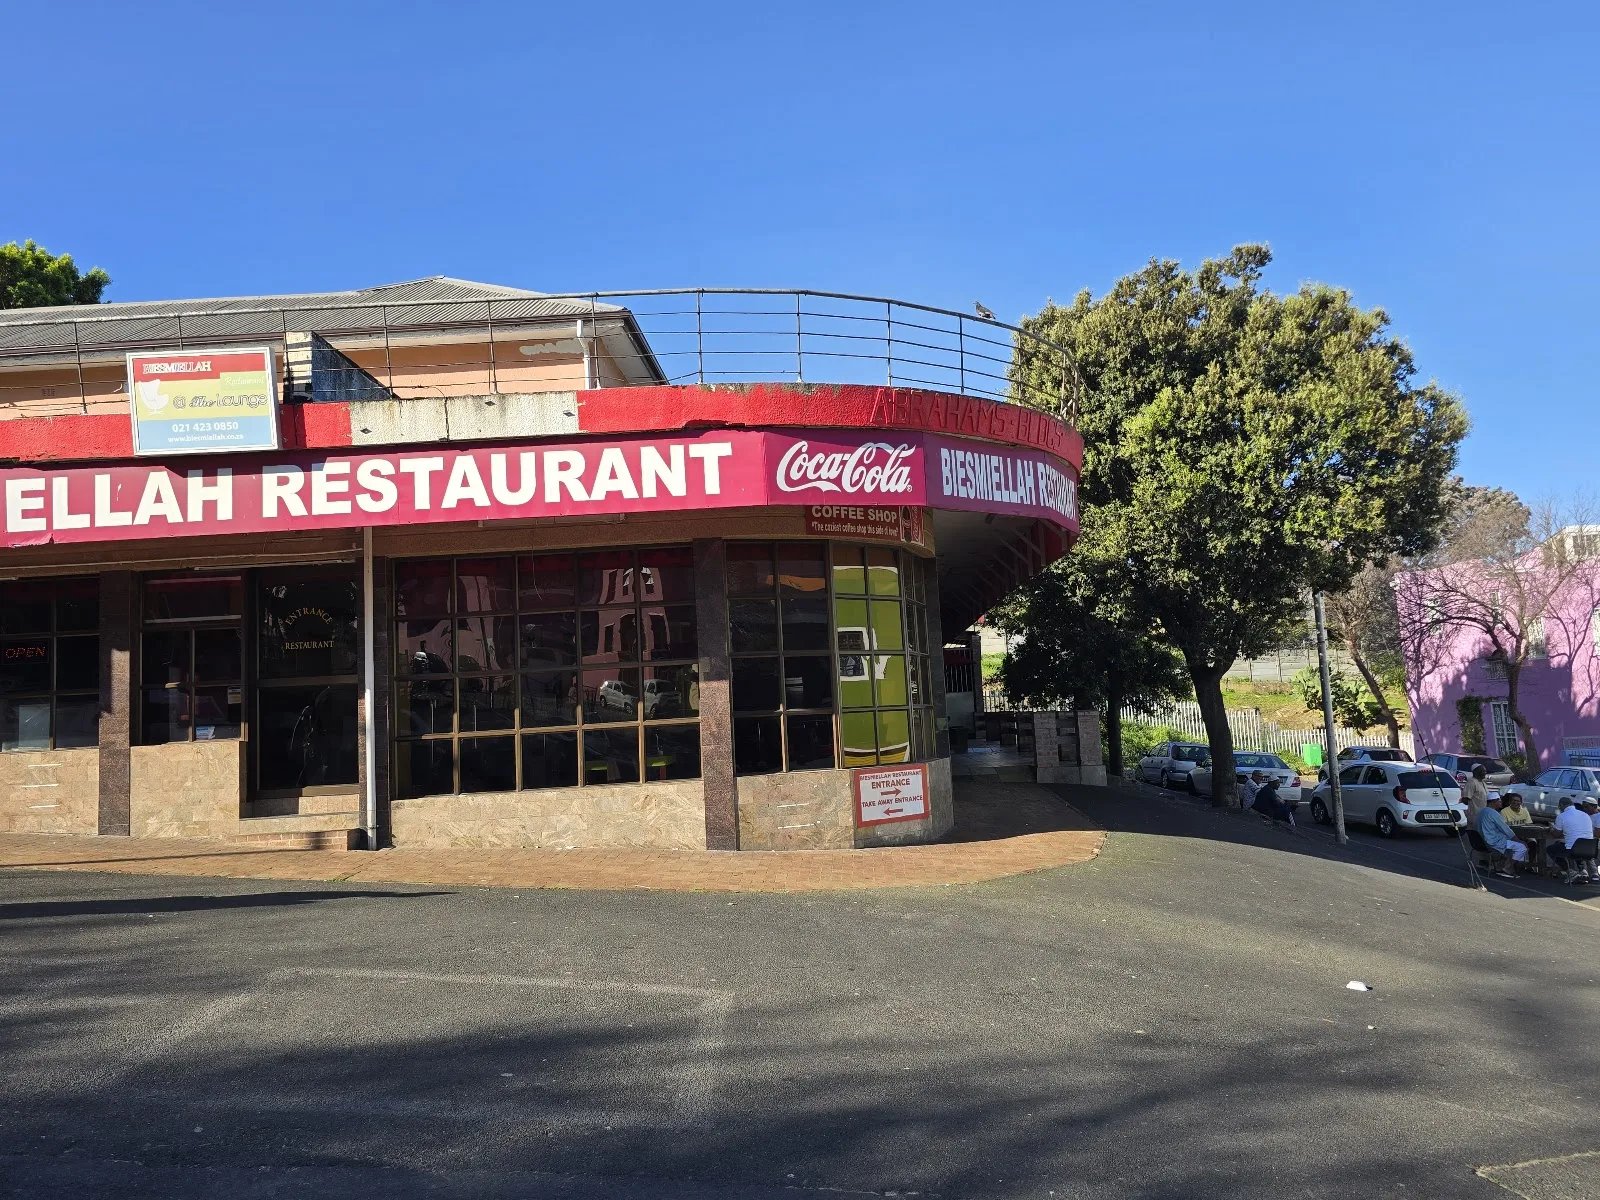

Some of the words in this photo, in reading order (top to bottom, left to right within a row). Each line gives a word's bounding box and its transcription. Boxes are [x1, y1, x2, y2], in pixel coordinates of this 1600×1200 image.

[189, 395, 216, 408] The
[172, 423, 190, 433] 021
[192, 422, 212, 432] 423
[214, 421, 239, 431] 0850
[167, 433, 244, 443] www.biesmiellah.co.za
[776, 440, 917, 493] Coca-Cola
[261, 442, 733, 518] RESTAURANT
[941, 447, 1036, 506] BIESMIELLAH
[811, 505, 865, 520] COFFEE
[868, 508, 897, 523] SHOP
[285, 607, 334, 626] ENTRANCE
[285, 640, 335, 650] RESTAURANT
[5, 646, 46, 659] OPEN
[871, 778, 911, 789] ENTRANCE
[862, 800, 876, 808] TAKE
[878, 798, 893, 806] AWAY
[895, 795, 923, 803] ENTRANCE
